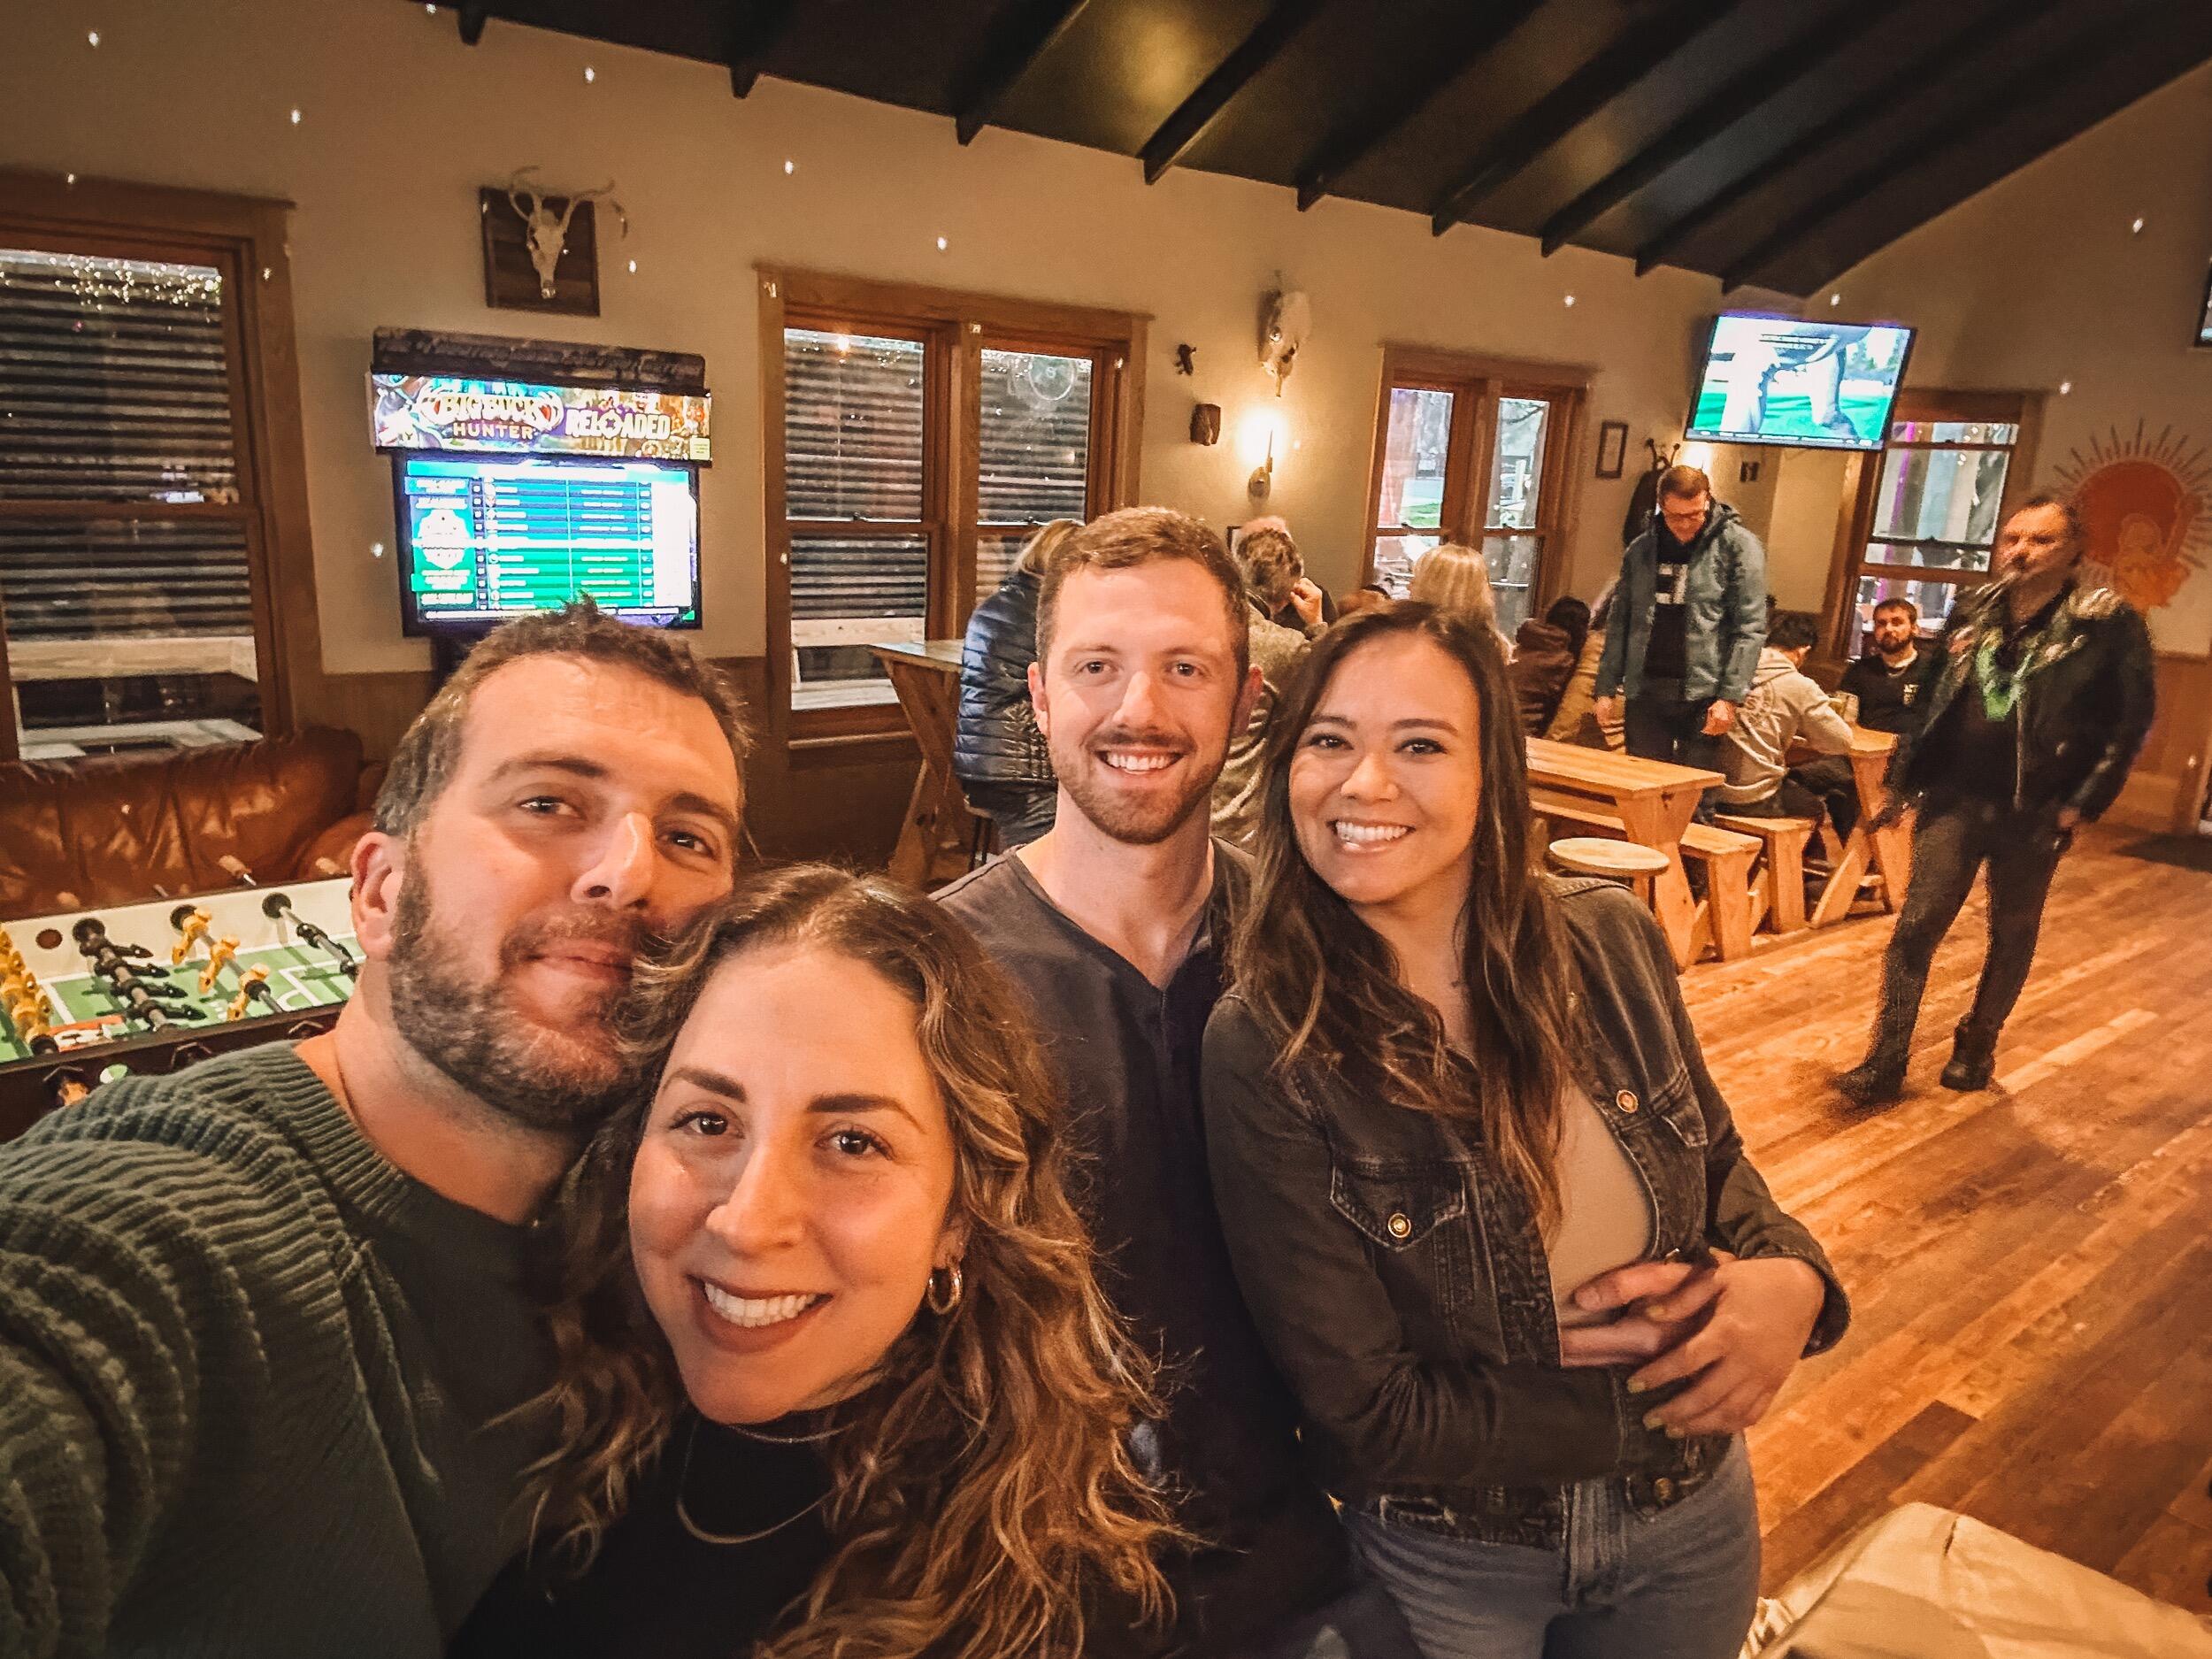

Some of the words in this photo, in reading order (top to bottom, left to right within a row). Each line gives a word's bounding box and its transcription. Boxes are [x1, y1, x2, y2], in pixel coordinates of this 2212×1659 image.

[442, 395, 483, 419] BIG
[482, 396, 537, 422] BUCK
[452, 422, 534, 440] HUNTER
[565, 408, 671, 440] RELOADED
